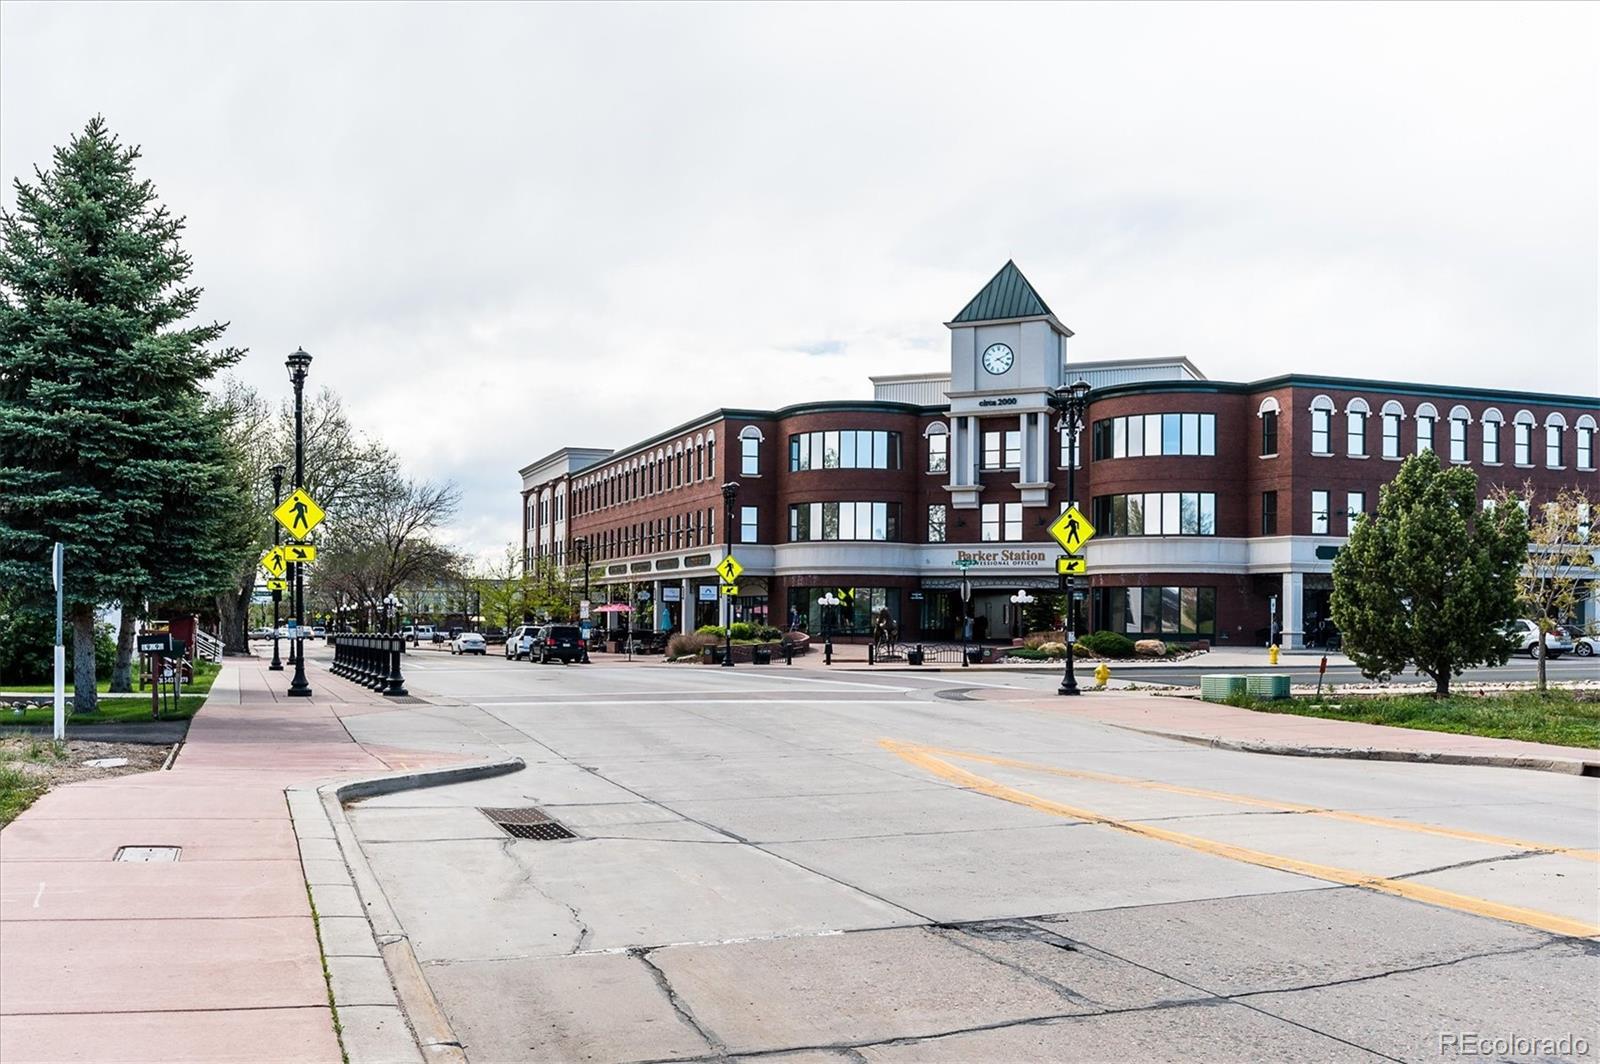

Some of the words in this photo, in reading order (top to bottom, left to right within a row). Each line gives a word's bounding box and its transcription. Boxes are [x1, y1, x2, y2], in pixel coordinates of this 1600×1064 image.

[978, 399, 997, 407] circa
[997, 397, 1018, 406] 2000
[957, 550, 999, 561] Parker
[1001, 549, 1046, 561] Station
